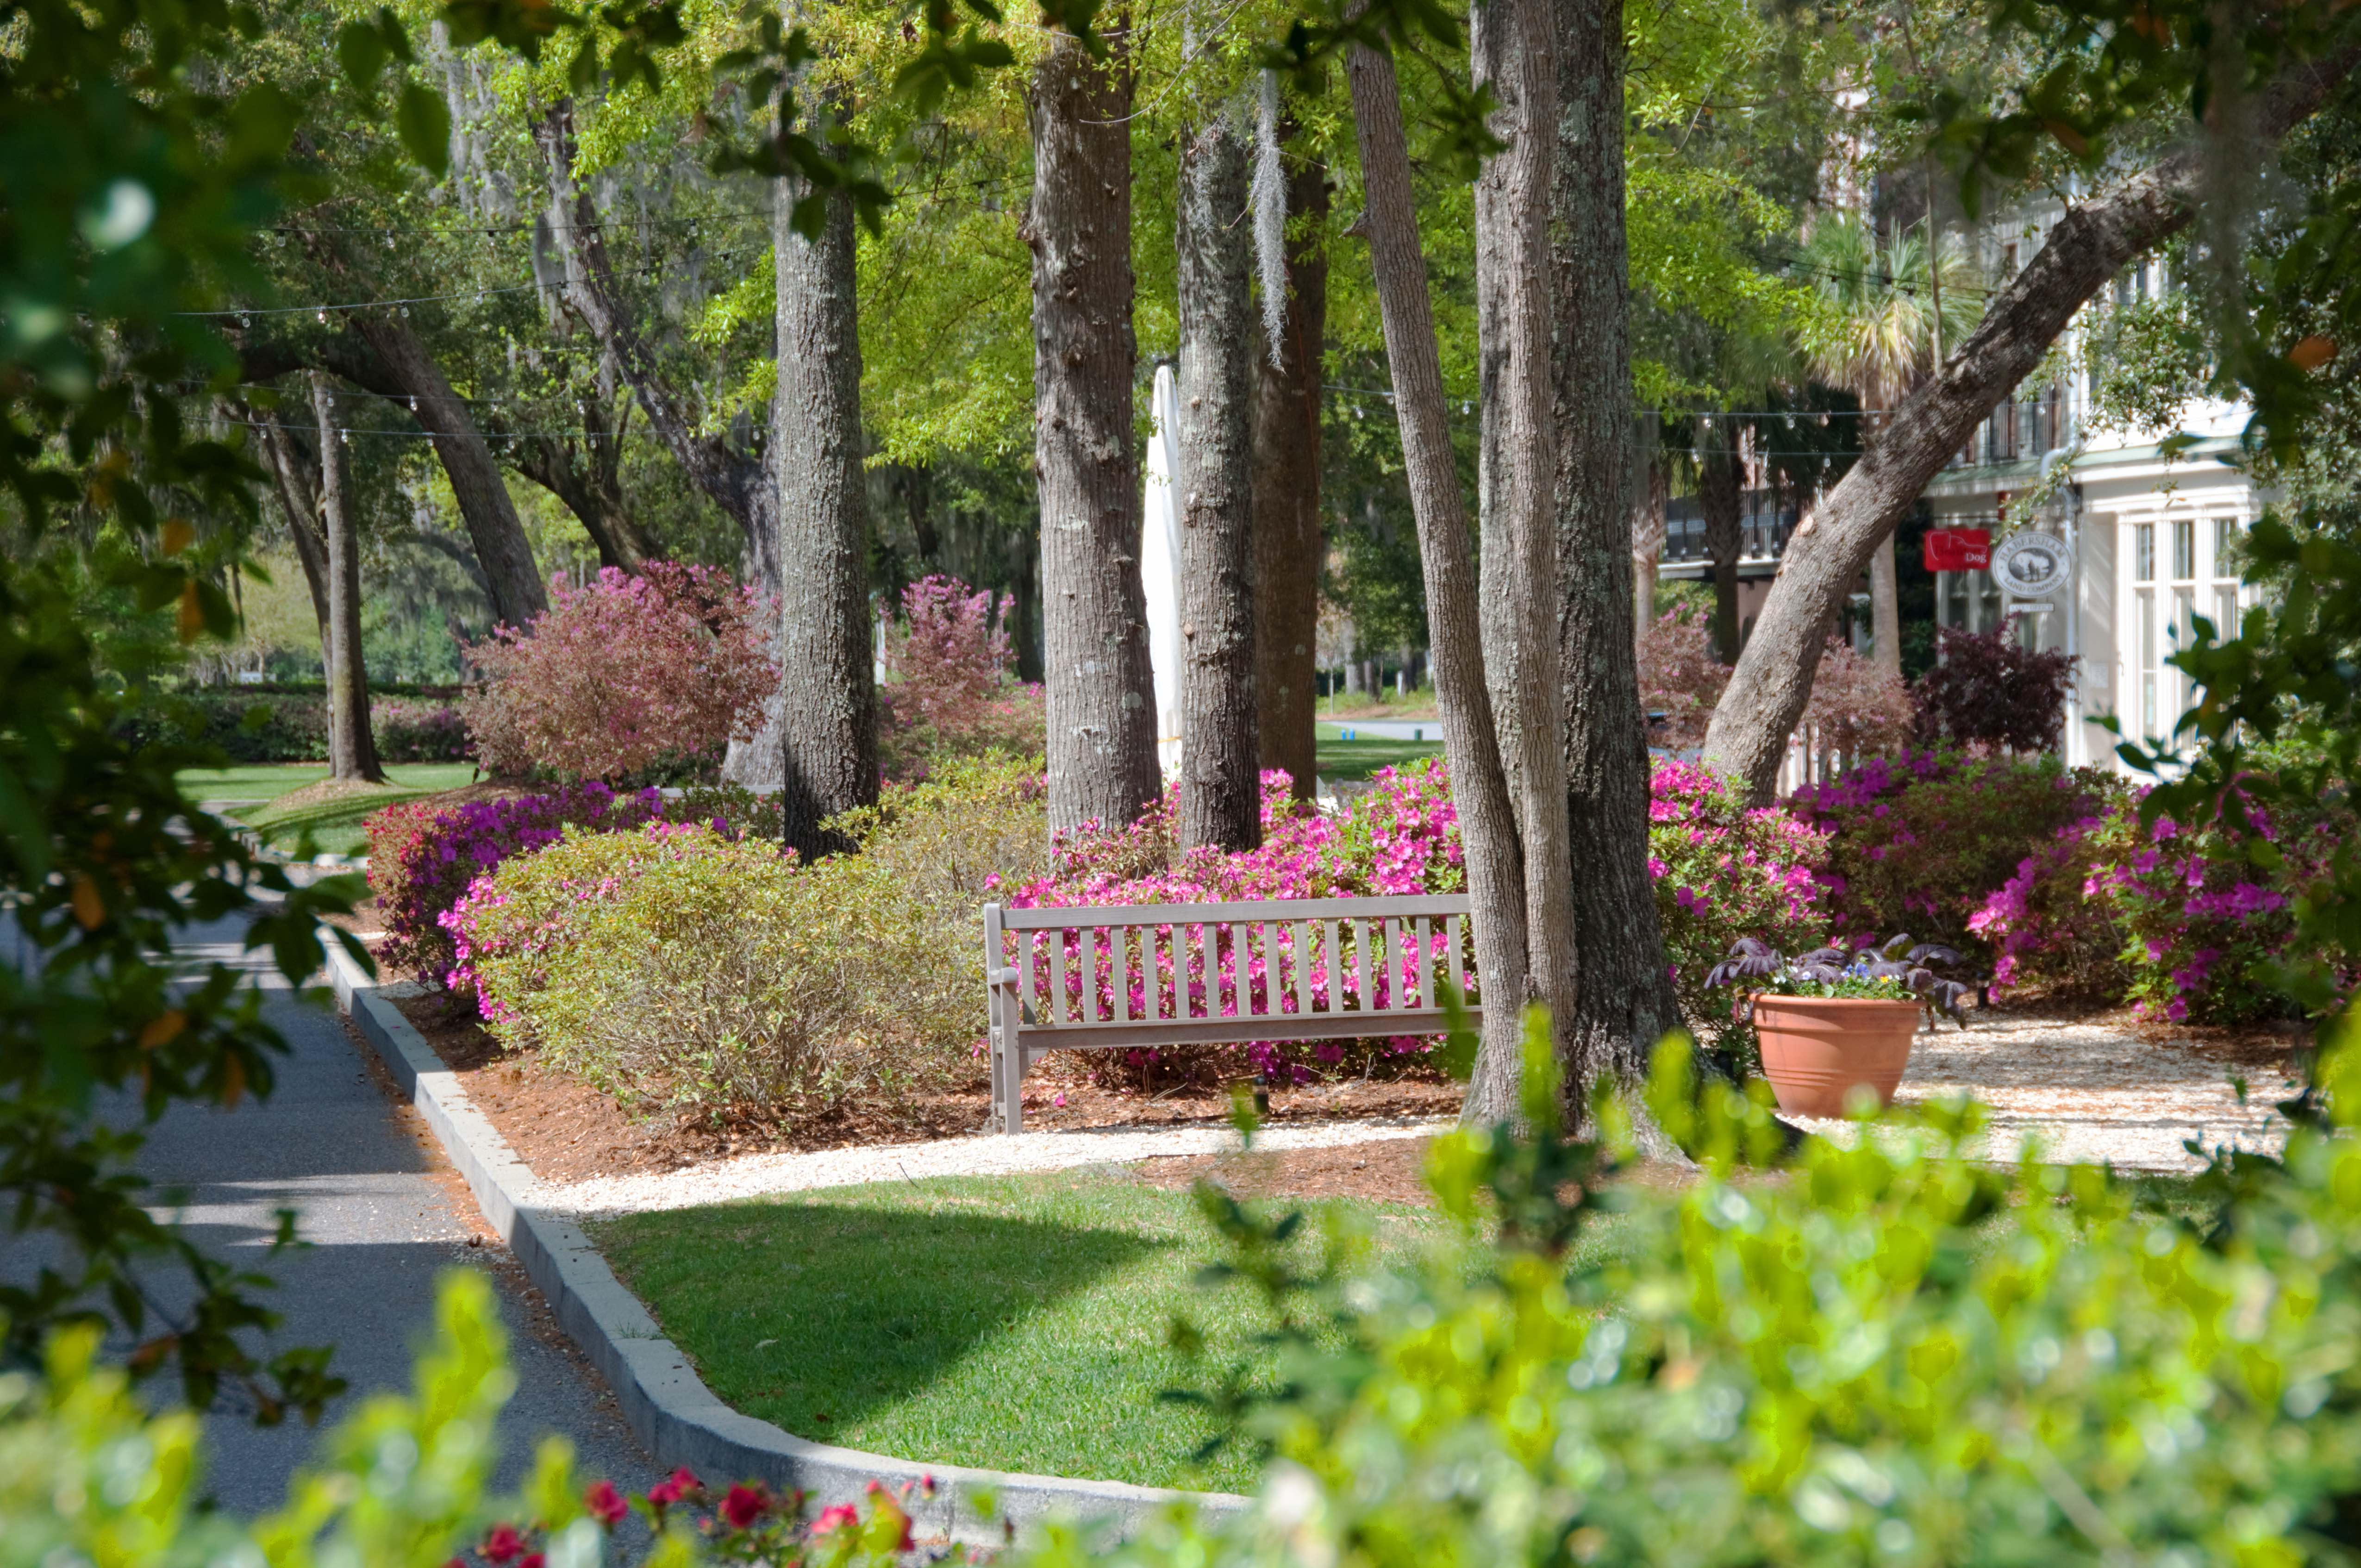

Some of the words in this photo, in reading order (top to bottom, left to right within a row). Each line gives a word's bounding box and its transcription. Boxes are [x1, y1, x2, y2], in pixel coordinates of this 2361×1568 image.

[1966, 553, 1986, 563] Dog
[1999, 536, 2066, 562] HABERSHAM
[2004, 576, 2026, 592] LAND
[2027, 572, 2063, 593] COMPANY
